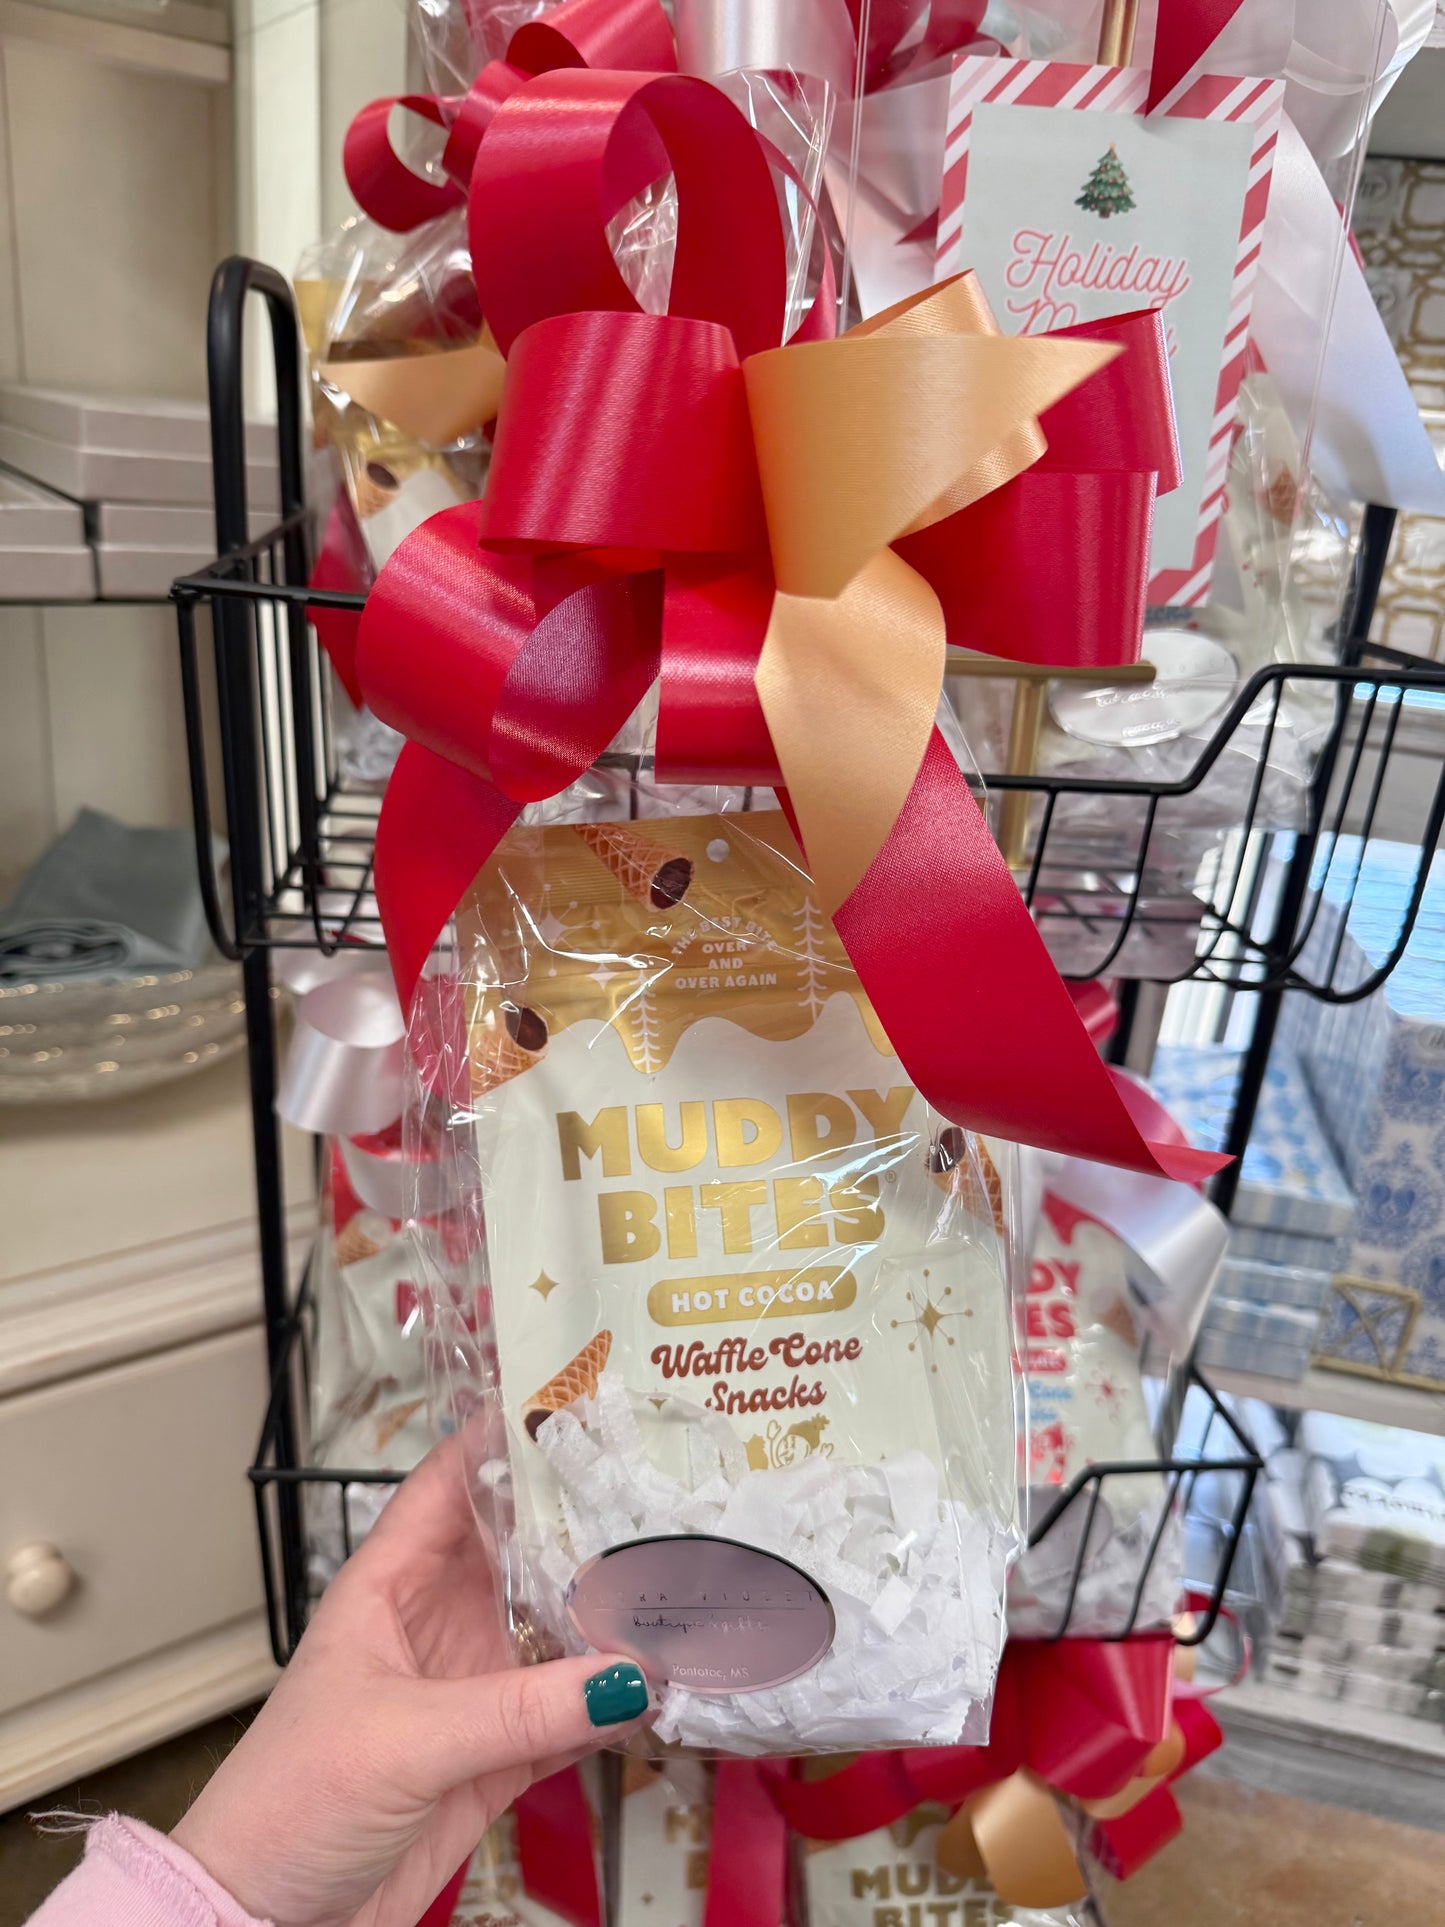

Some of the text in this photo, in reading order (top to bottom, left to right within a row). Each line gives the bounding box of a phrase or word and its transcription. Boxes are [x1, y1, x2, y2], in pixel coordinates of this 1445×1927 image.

[1006, 229, 1191, 309] Holiday
[699, 915, 742, 933] BEST
[702, 940, 748, 954] OVER
[708, 957, 744, 970] AND
[674, 973, 777, 989] OVER AGAIN
[556, 1086, 916, 1181] MUDDY
[598, 1172, 886, 1264] BITES
[671, 1279, 834, 1313] HOT COCOA
[651, 1332, 863, 1379] Waffle Cone
[705, 1374, 828, 1415] Snacks
[672, 1665, 750, 1680] Pontotoc, MS
[850, 1862, 998, 1901] MUD
